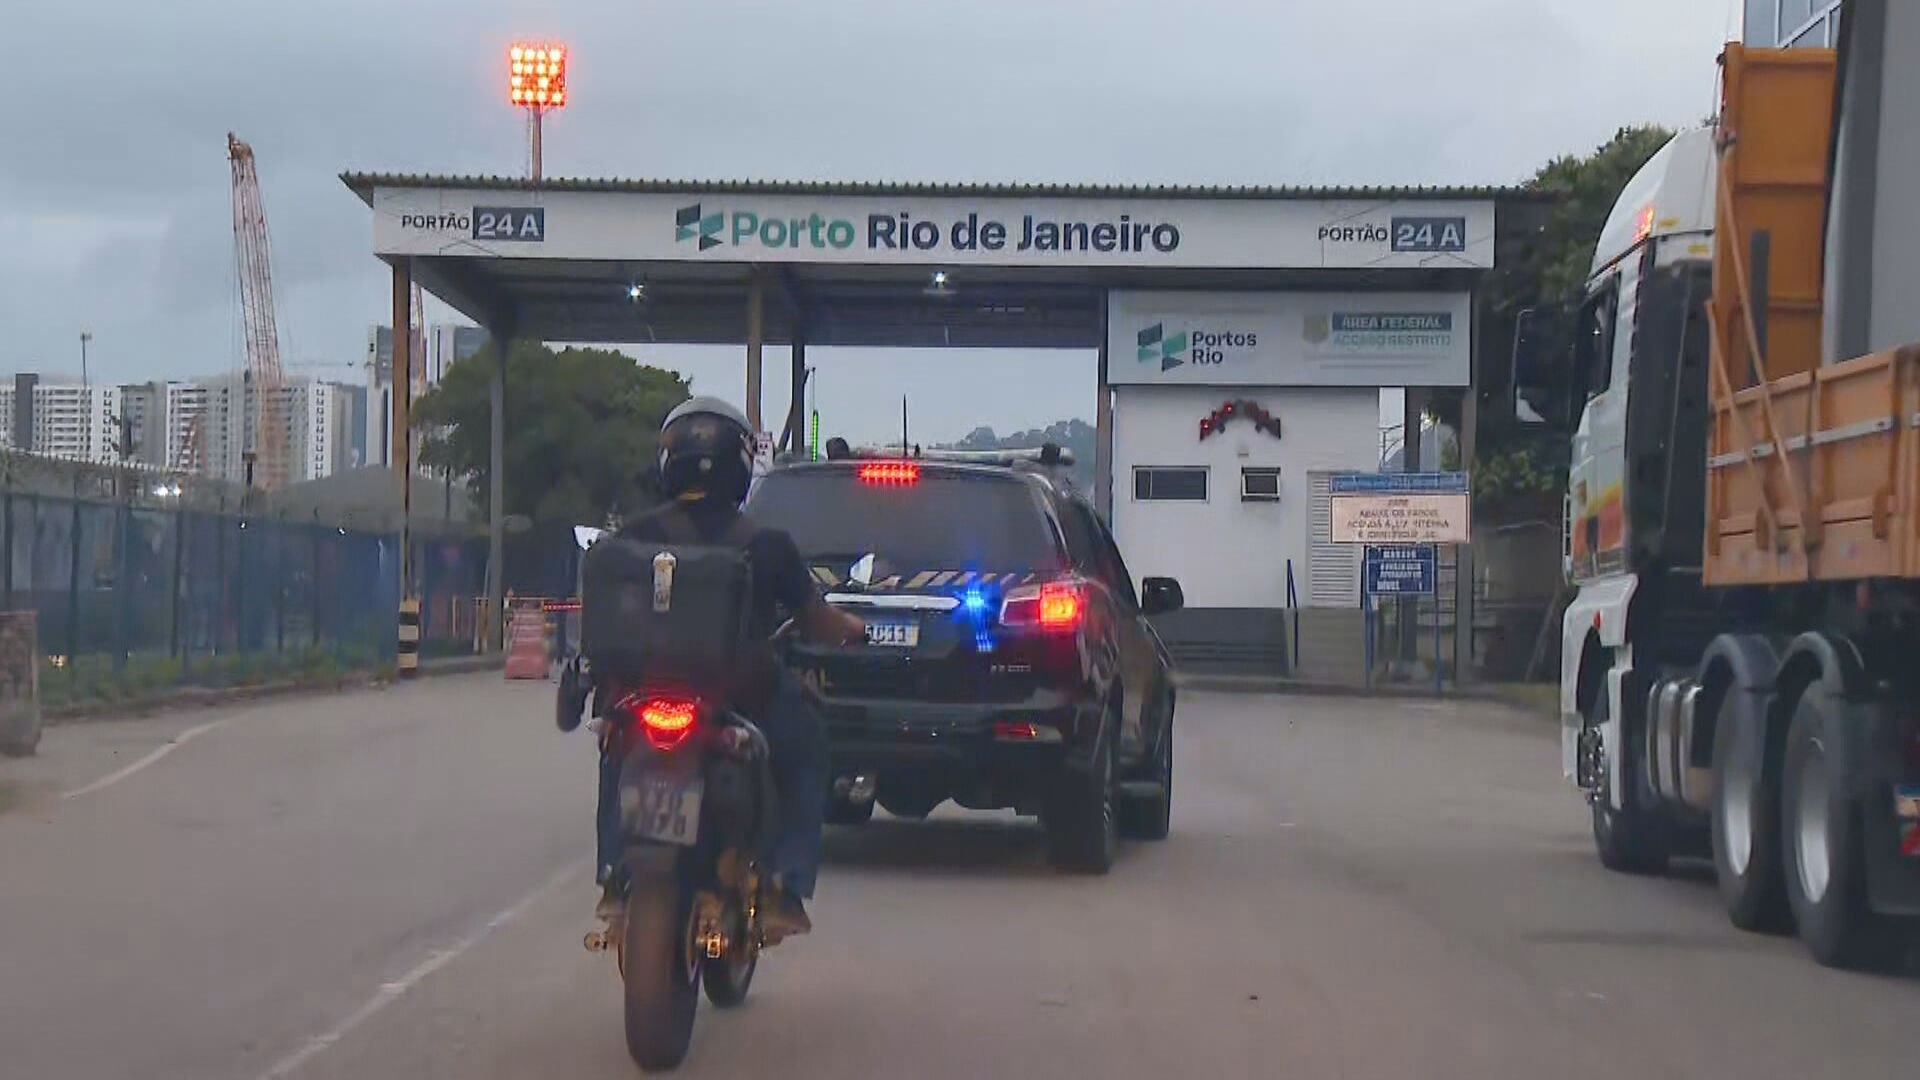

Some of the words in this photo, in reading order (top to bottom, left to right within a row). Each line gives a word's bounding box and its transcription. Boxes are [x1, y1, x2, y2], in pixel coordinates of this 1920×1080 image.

[401, 212, 470, 231] PORTÃO
[478, 213, 514, 237] 24
[520, 214, 541, 237] A
[731, 211, 855, 249] Porto
[867, 213, 939, 250] Rio
[951, 213, 1011, 250] de
[1017, 215, 1181, 253] Janeiro
[1317, 224, 1387, 243] PORTÃO
[1397, 223, 1436, 247] 24
[1441, 224, 1463, 247] A
[1381, 316, 1441, 329] FEDERAL
[1192, 330, 1257, 347] Portos
[1192, 348, 1224, 365] Rio
